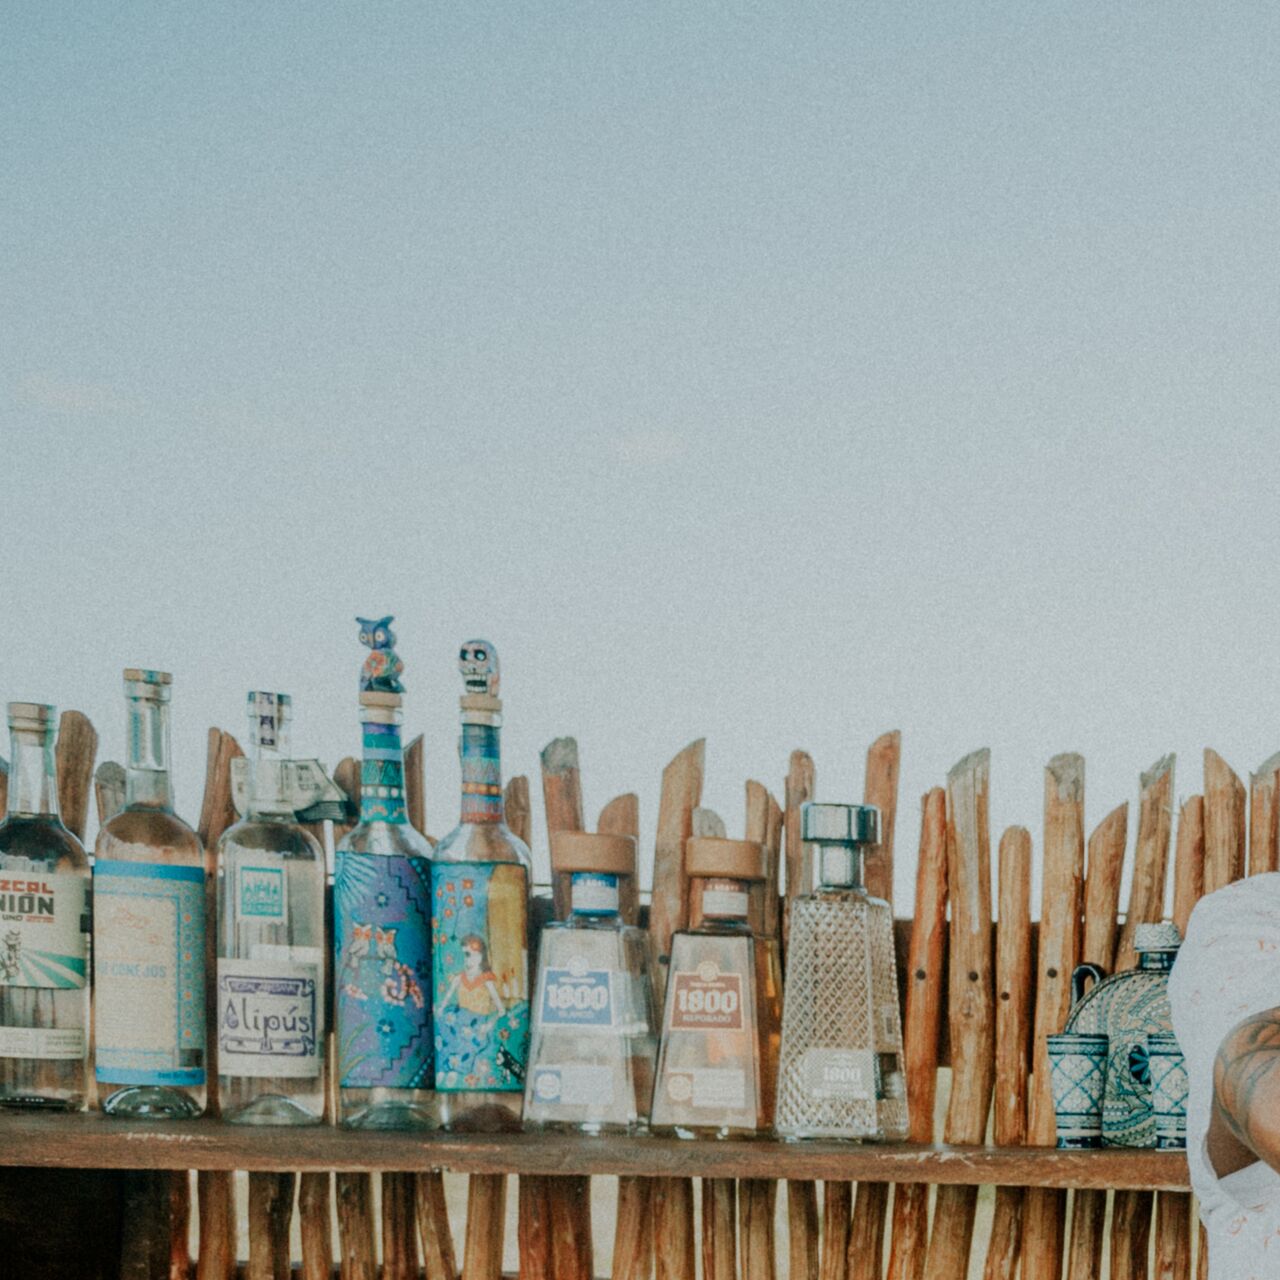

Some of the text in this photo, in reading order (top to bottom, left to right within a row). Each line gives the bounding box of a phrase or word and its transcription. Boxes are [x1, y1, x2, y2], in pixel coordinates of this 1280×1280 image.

[546, 983, 609, 1010] 1800
[677, 989, 738, 1014] 1800
[224, 997, 311, 1040] Alipús
